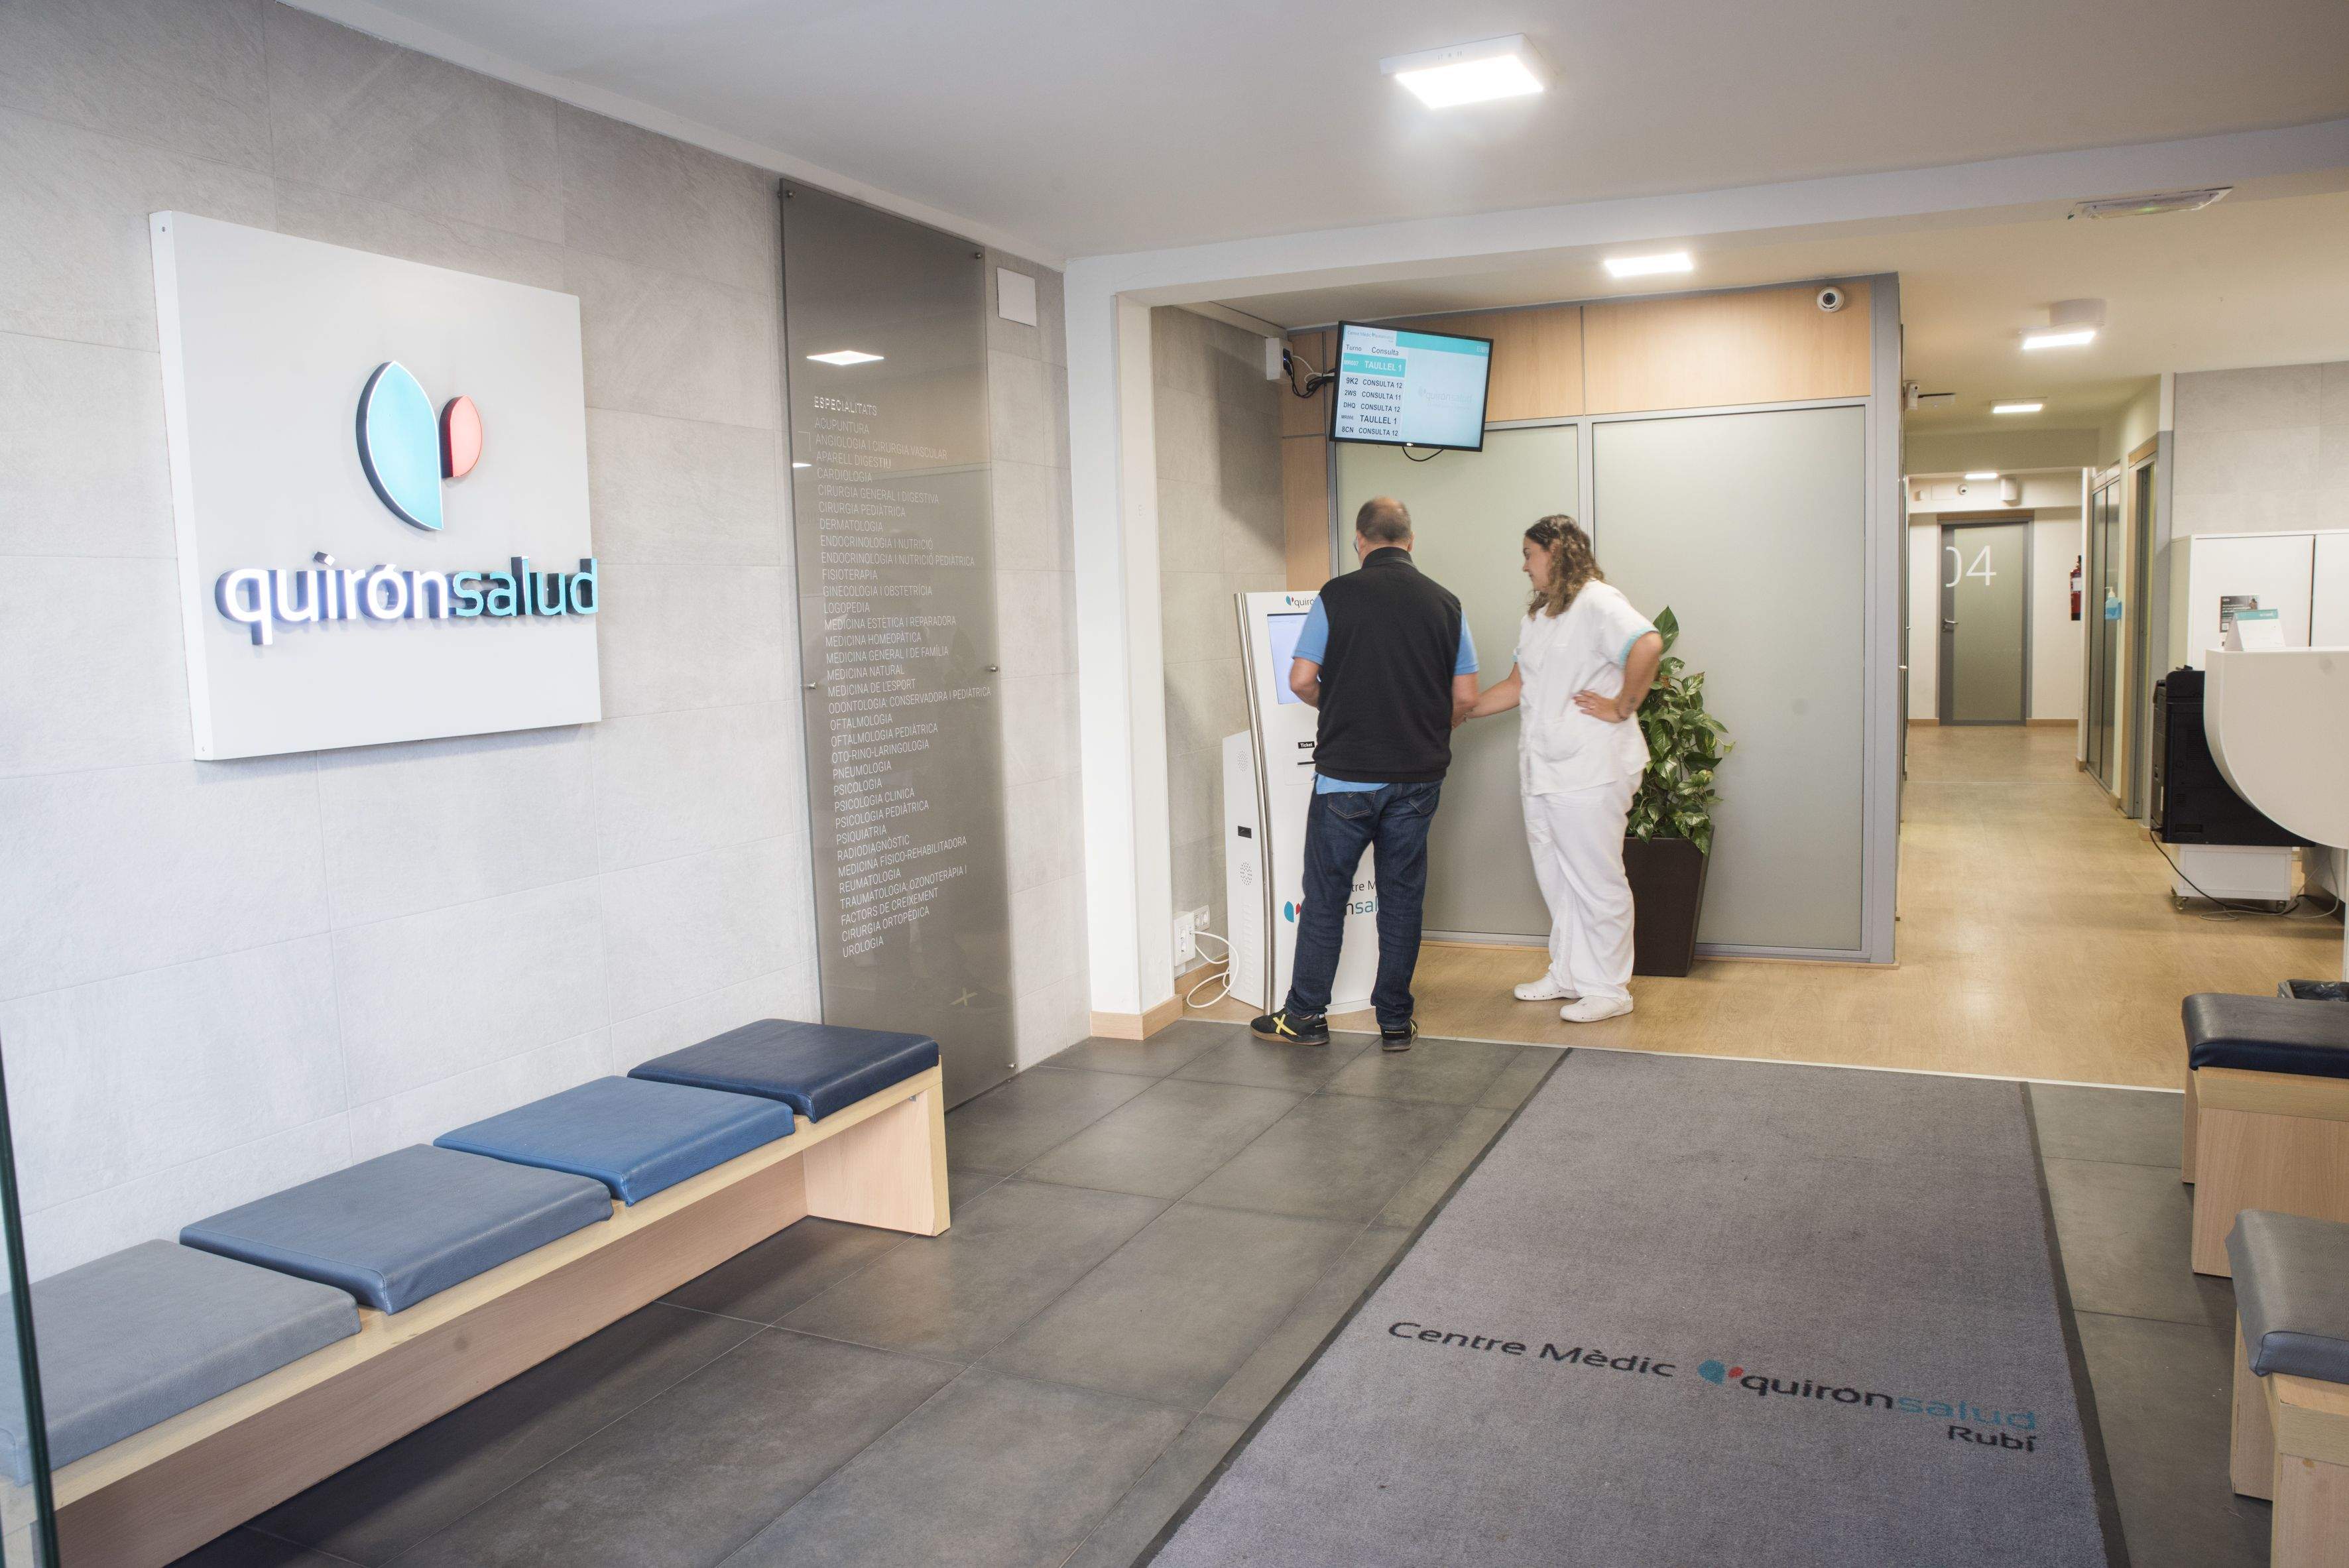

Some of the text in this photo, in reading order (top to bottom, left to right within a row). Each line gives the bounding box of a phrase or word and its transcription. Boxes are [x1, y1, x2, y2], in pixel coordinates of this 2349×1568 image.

[1371, 346, 1399, 356] Consulta
[1364, 361, 1396, 371] TAULLEL
[1362, 379, 1394, 388] CONSULTA
[1361, 391, 1393, 400] CONSULTA
[814, 396, 877, 416] ESPECIALITATS
[1360, 403, 1392, 412] CONSULTA
[815, 417, 869, 434] ACUPUNTURA
[1360, 414, 1391, 424] TAULLEL
[815, 434, 867, 450] ANGIOLOGIA
[872, 440, 909, 455] CIRURGIA
[910, 446, 947, 461] VASCULAR
[817, 450, 891, 469] APARELL DIGESTIU
[817, 467, 873, 483] CARDIOLOGIA
[818, 484, 858, 498] CIRURGIA
[861, 487, 896, 501] GENERAL
[902, 491, 939, 505] DIGESTIVA
[819, 501, 859, 515] CIRURGIA
[819, 518, 884, 532] DERMATOLOGIA
[820, 535, 892, 548] ENDOCRINOLOGIA
[898, 537, 934, 551] NUTRICIÓ
[821, 552, 893, 565] ENDOCRINOLOGIA
[899, 553, 934, 566] NUTRICIÓ
[822, 569, 878, 581] FISIOTERAPIA
[823, 585, 878, 597] GINECOLOGIA
[823, 601, 871, 614] LOGOPEDIA
[824, 618, 865, 631] MEDICINA
[910, 615, 957, 627] REPARADORA
[825, 634, 867, 648] MEDICINA
[826, 651, 867, 664] MEDICINA
[869, 647, 904, 661] GENERAL
[910, 647, 920, 658] DE
[921, 643, 949, 658] FAMÍLIA
[827, 664, 905, 681] MEDICINA NATURAL
[828, 678, 916, 697] MEDICINA DE L'ESPORT
[889, 689, 947, 707] CONSERVADORA
[830, 713, 893, 731] OFTALMOLOGIA
[831, 729, 894, 748] OFTALMOLOGIA
[831, 739, 930, 764] OTO-RINO-LARINGOLOGIA
[833, 760, 892, 780] PNEUMOLOGIA
[833, 777, 882, 796] PSICOLOGIA
[835, 794, 883, 813] PSICOLOGIA
[835, 810, 884, 829] PSICOLOGIA
[836, 824, 887, 845] PSIQUIATRIA
[838, 857, 878, 878] MEDICINA
[839, 867, 902, 894] REUMATOLOGIA
[841, 887, 939, 926] FACTORS DE CREIXEMENT
[842, 920, 881, 942] CIRURGIA
[843, 935, 884, 958] UROLOGIA
[1388, 1321, 1526, 1355] Centre
[1539, 1343, 1676, 1377] Mèdic
